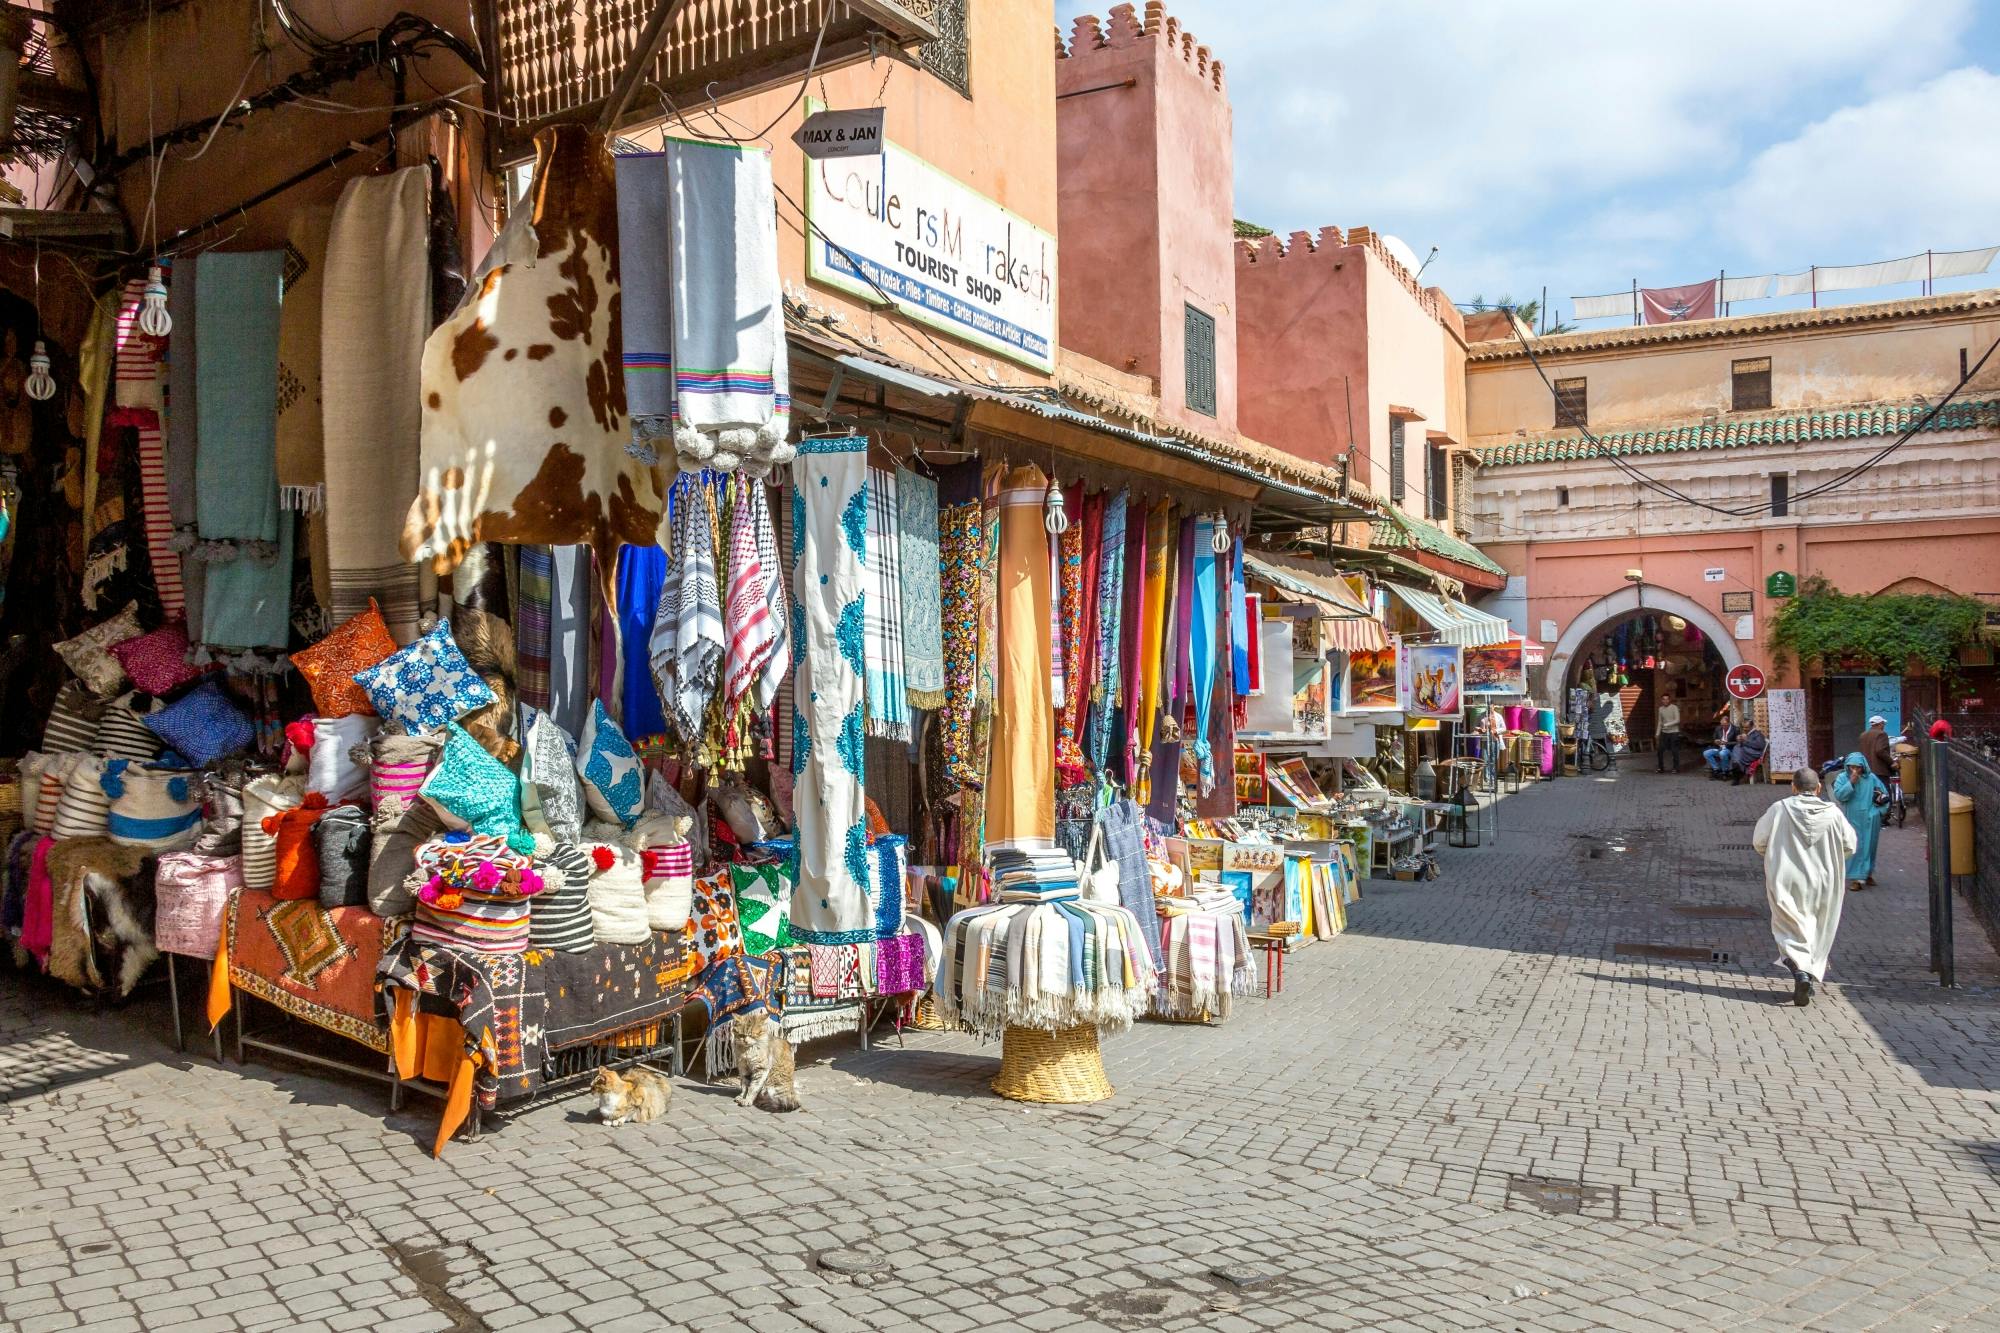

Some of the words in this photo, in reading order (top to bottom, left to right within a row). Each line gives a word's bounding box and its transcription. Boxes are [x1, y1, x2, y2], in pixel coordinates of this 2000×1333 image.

[803, 129, 832, 143] MAX
[836, 129, 845, 141] &
[849, 127, 877, 140] JAN
[879, 269, 901, 293] Kodak
[905, 280, 921, 301] Piles
[925, 289, 950, 313] Timbres
[953, 301, 972, 324] Cartes
[972, 311, 995, 334] postales
[995, 320, 1002, 336] et
[894, 240, 959, 287] TOURIST
[966, 275, 1002, 306] SHOP
